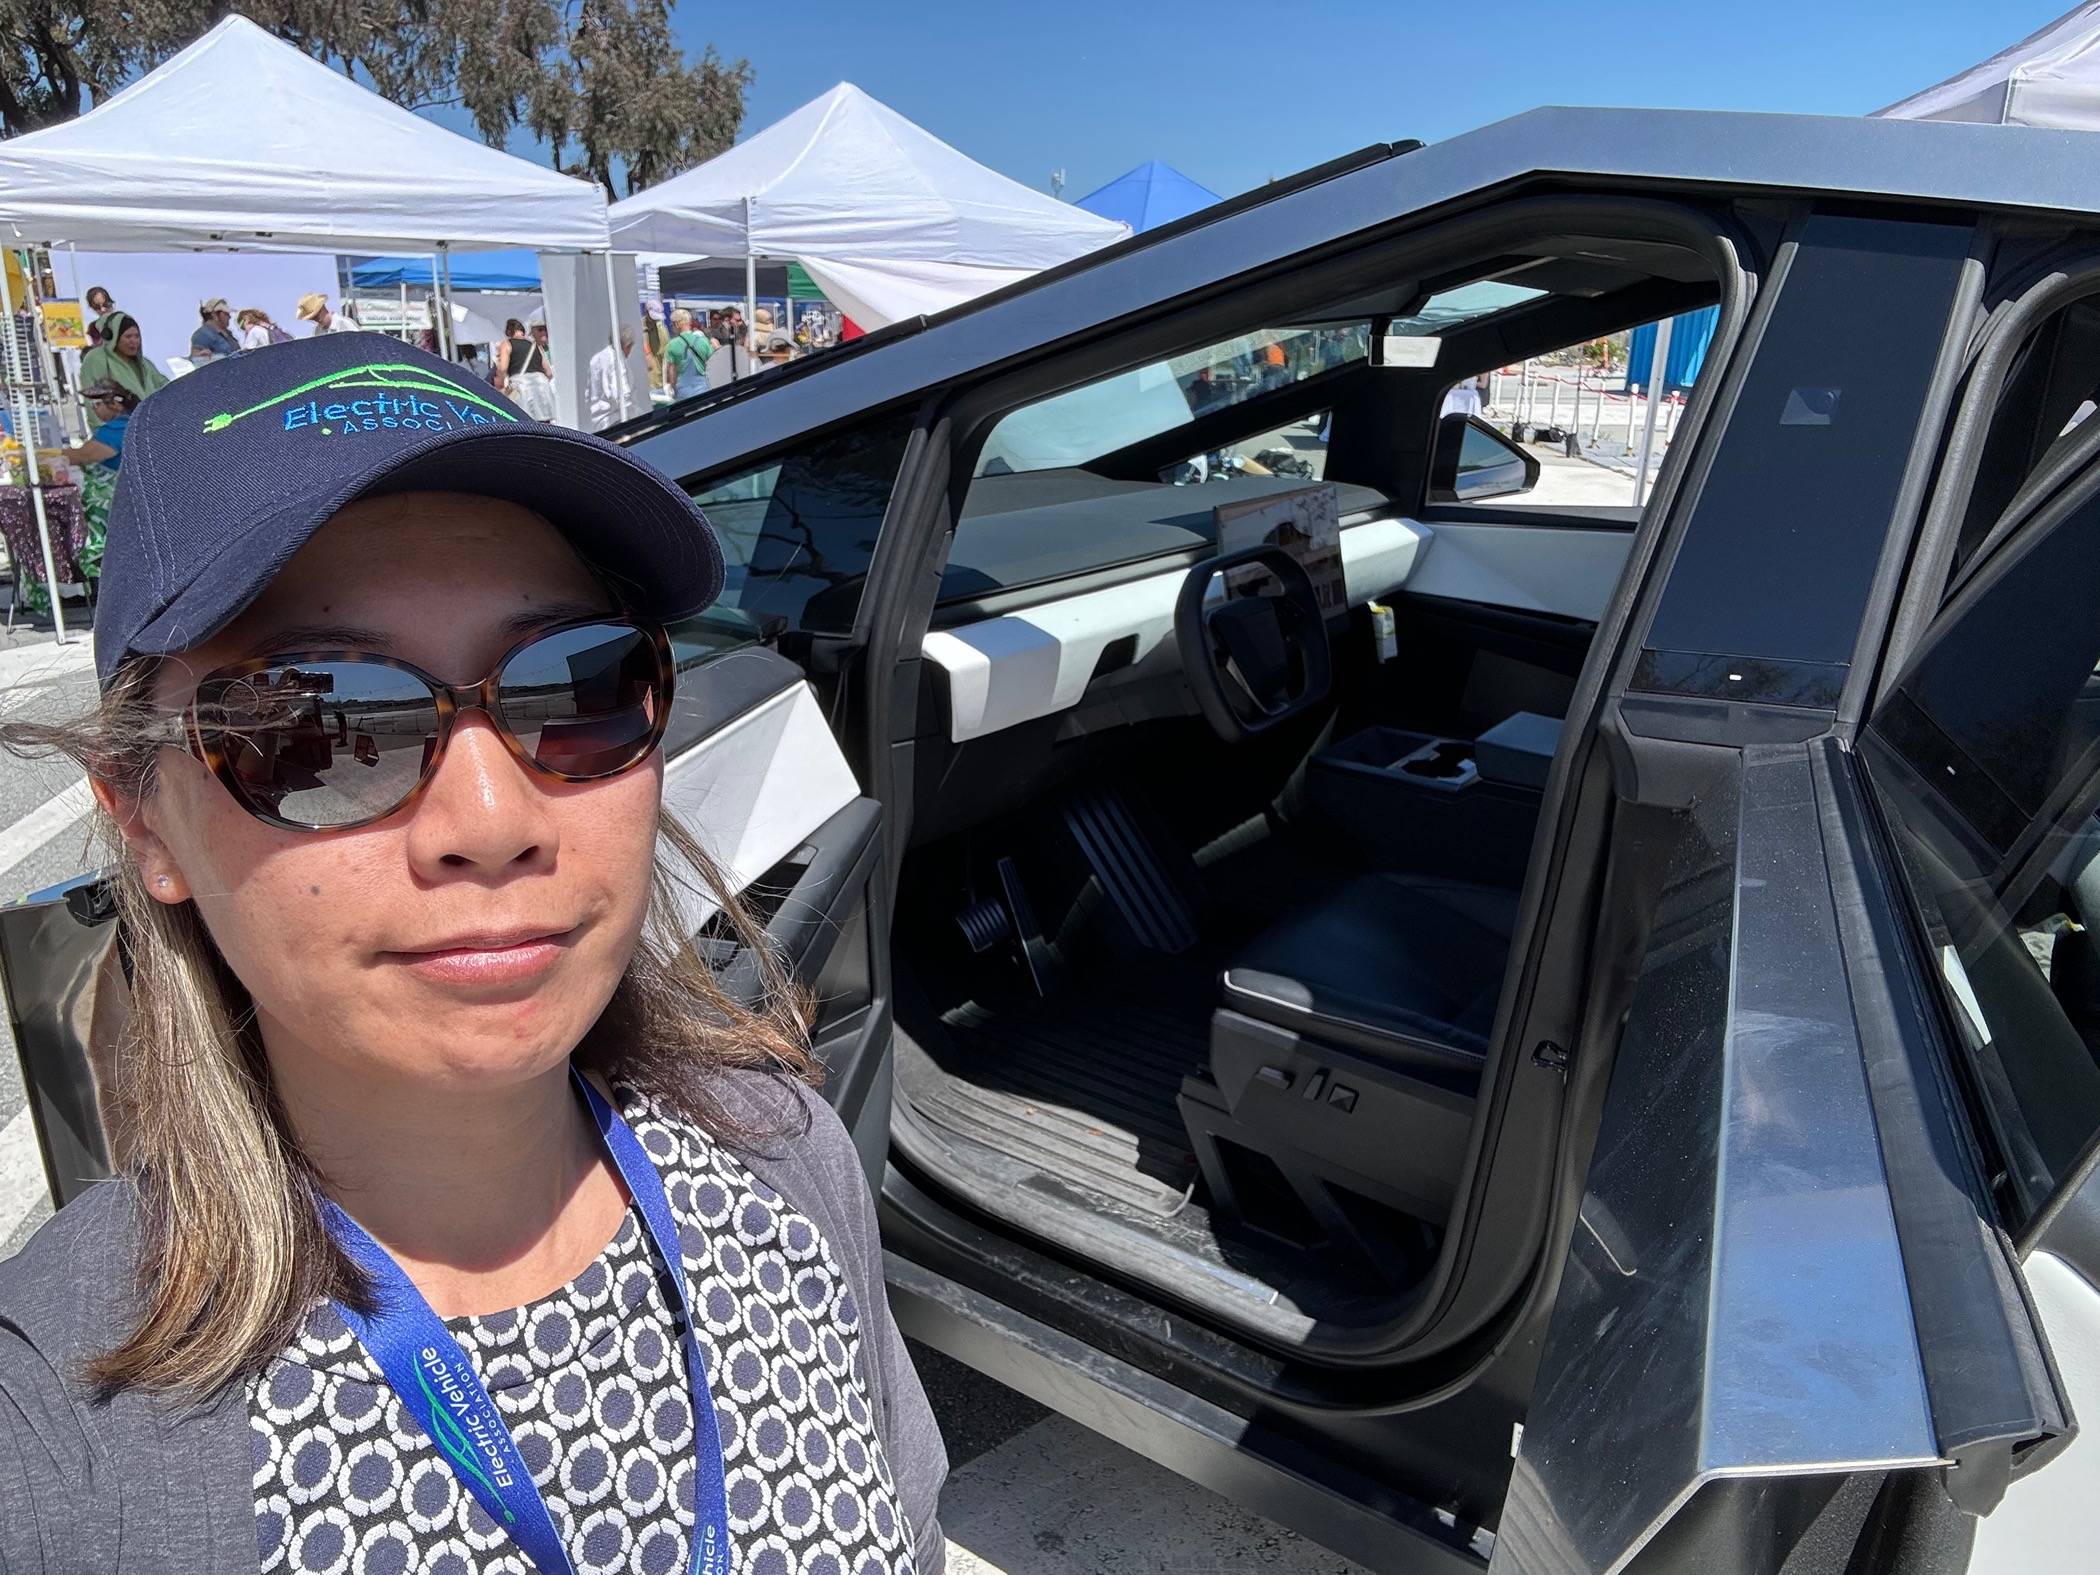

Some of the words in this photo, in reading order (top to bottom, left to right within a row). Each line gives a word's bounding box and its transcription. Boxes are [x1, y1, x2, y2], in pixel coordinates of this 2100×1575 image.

[284, 393, 444, 432] Electric
[445, 400, 496, 430] Ve
[343, 416, 460, 435] ASSOCI
[422, 1347, 470, 1417] Vehicle
[454, 1362, 511, 1453] ASSOCIATION
[465, 1414, 513, 1488] Electric
